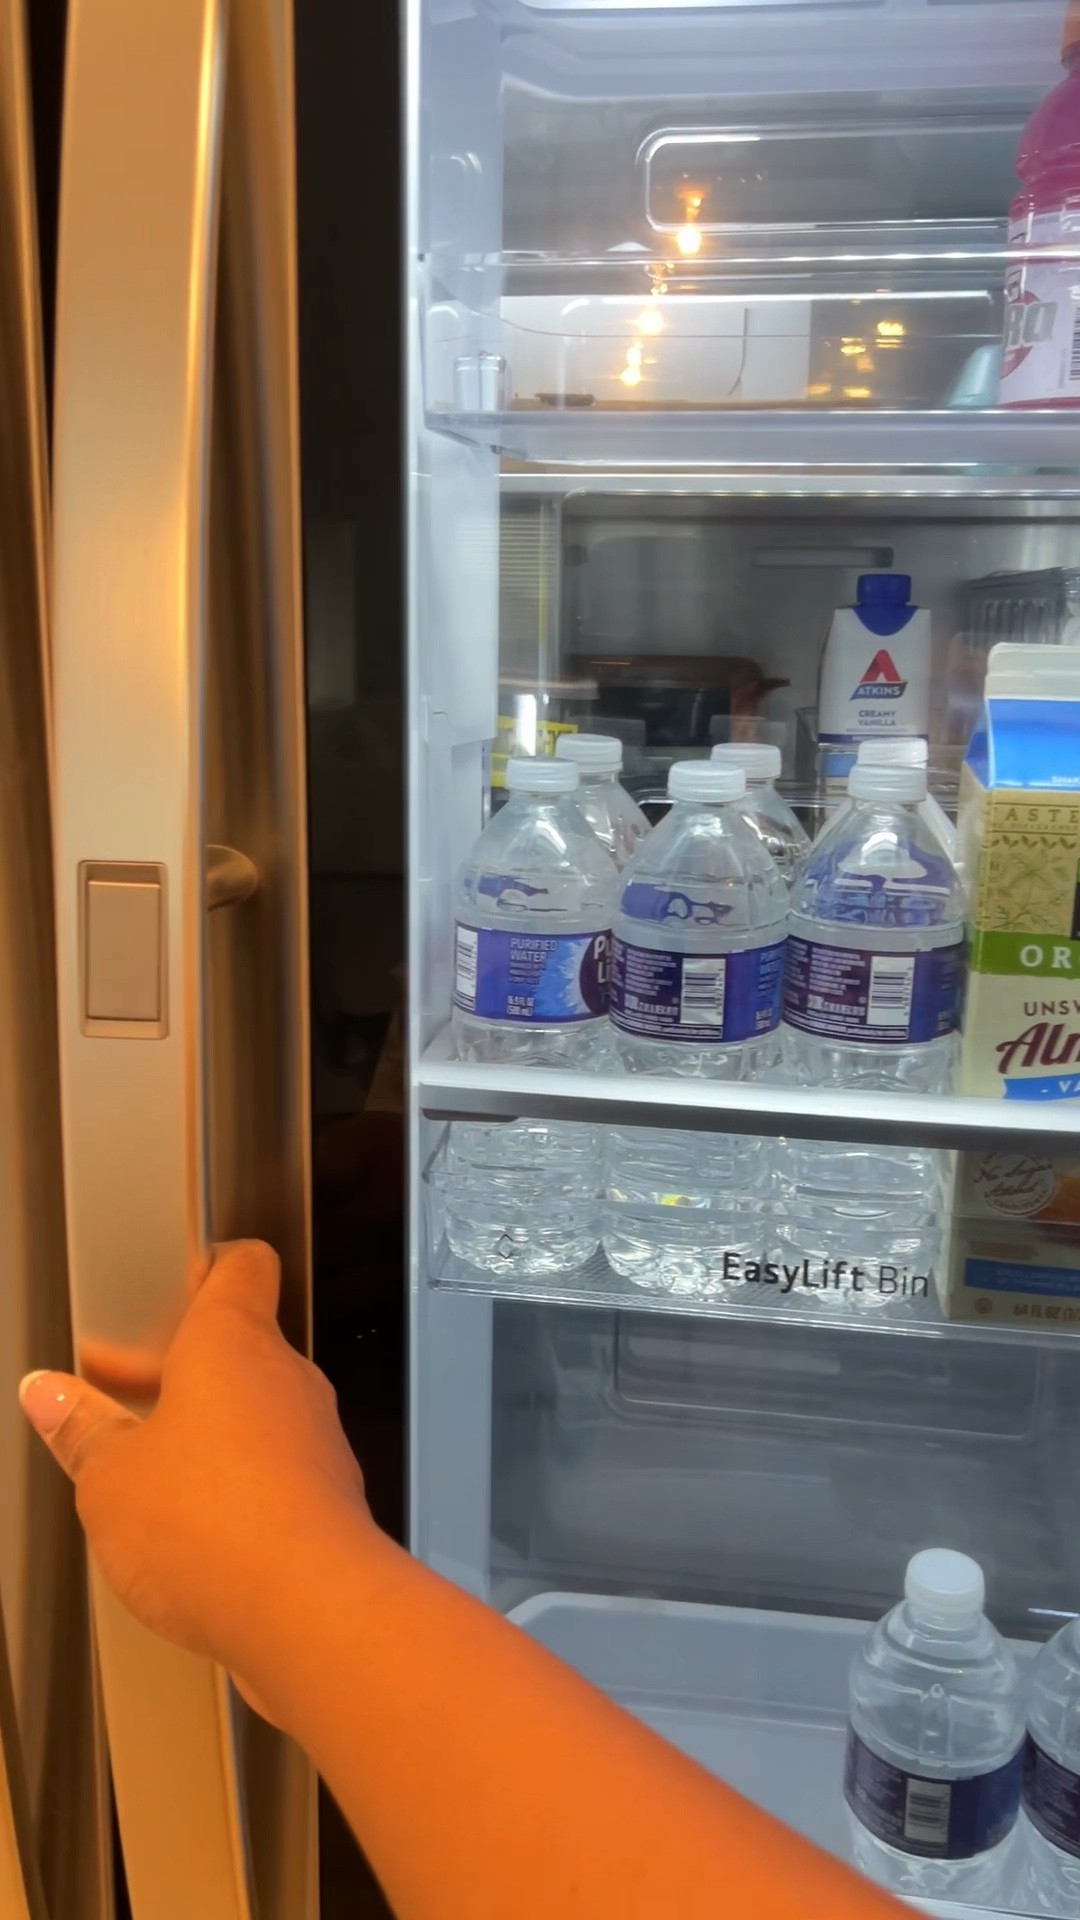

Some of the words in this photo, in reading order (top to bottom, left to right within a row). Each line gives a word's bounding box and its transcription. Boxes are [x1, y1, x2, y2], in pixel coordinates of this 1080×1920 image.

[857, 686, 901, 696] ATKINS
[858, 710, 896, 718] CREAMY
[994, 807, 1080, 824] ASTE
[510, 937, 557, 951] PURIFIED
[510, 951, 547, 962] WATER
[1020, 944, 1080, 969] OR
[723, 1251, 865, 1294] EasyLift
[879, 1265, 929, 1297] Bin
